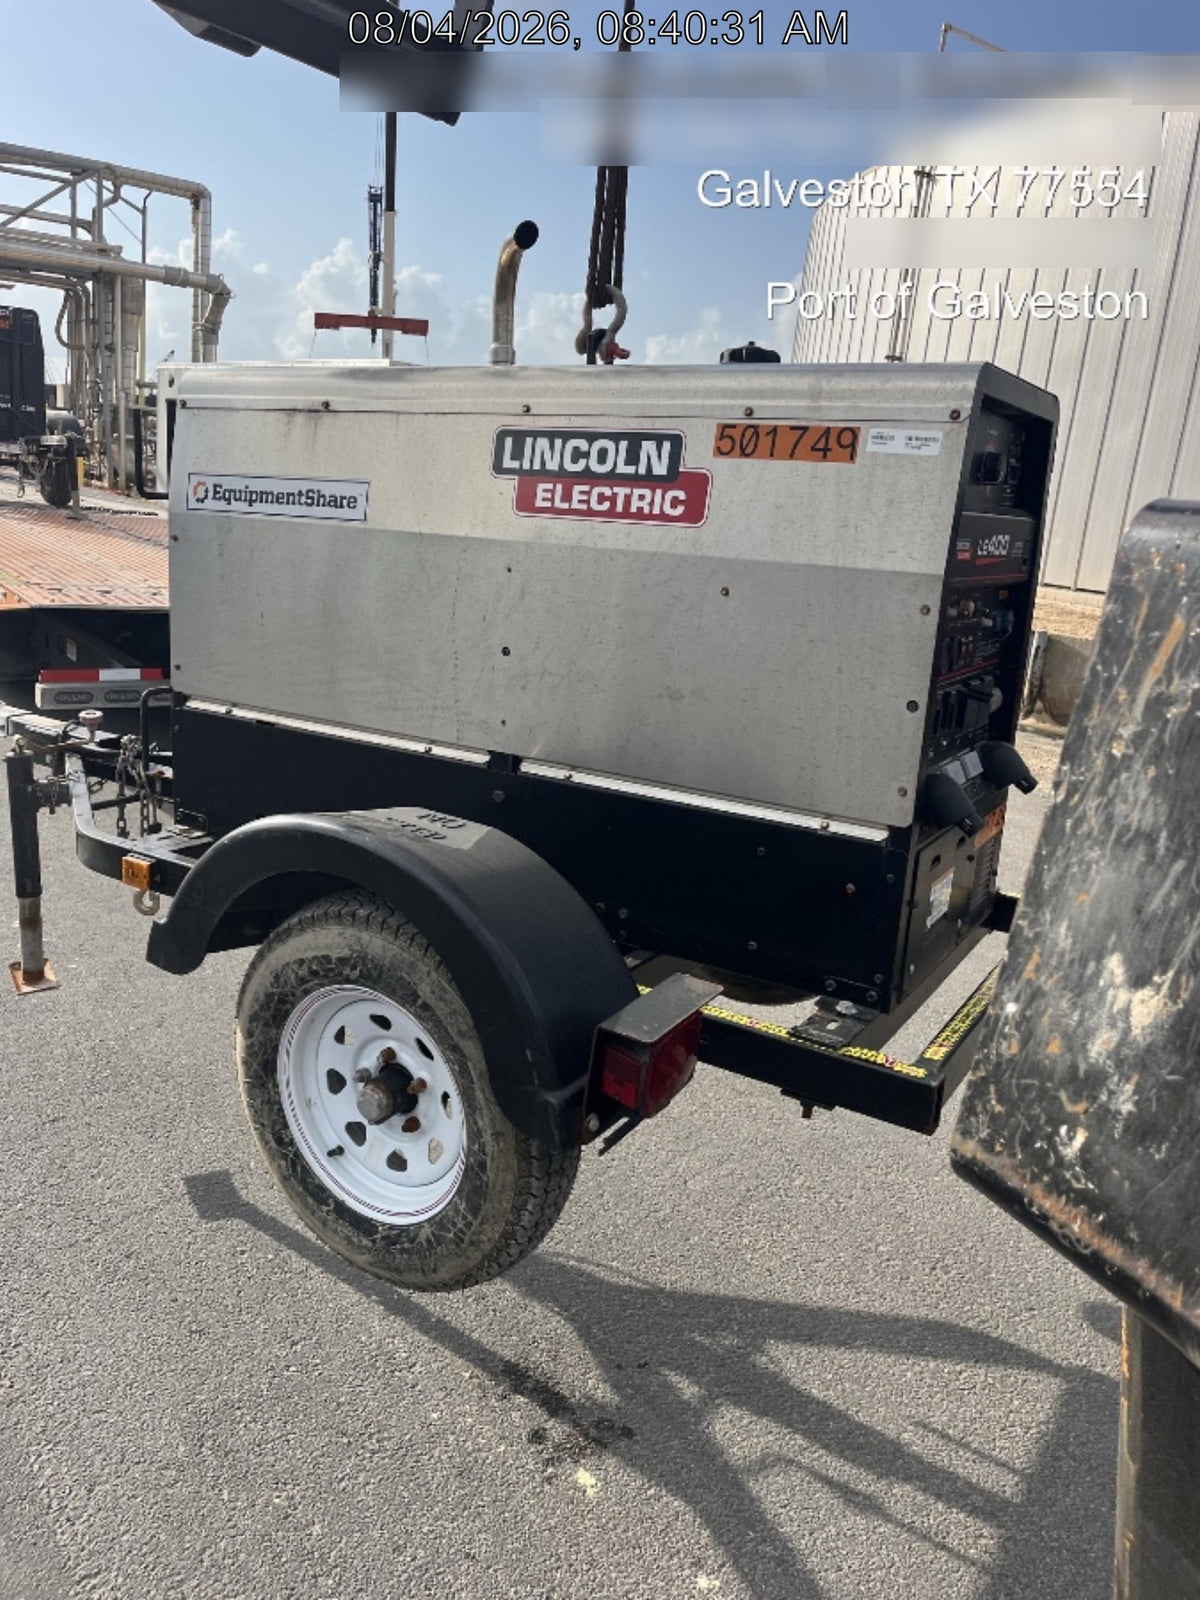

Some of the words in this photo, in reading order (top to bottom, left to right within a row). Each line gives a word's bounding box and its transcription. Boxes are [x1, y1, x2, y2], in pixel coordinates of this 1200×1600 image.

[502, 436, 671, 476] LINCOLN
[715, 424, 857, 462] 501749
[212, 483, 358, 509] EquipmentShare
[534, 482, 687, 516] ELECTRIC
